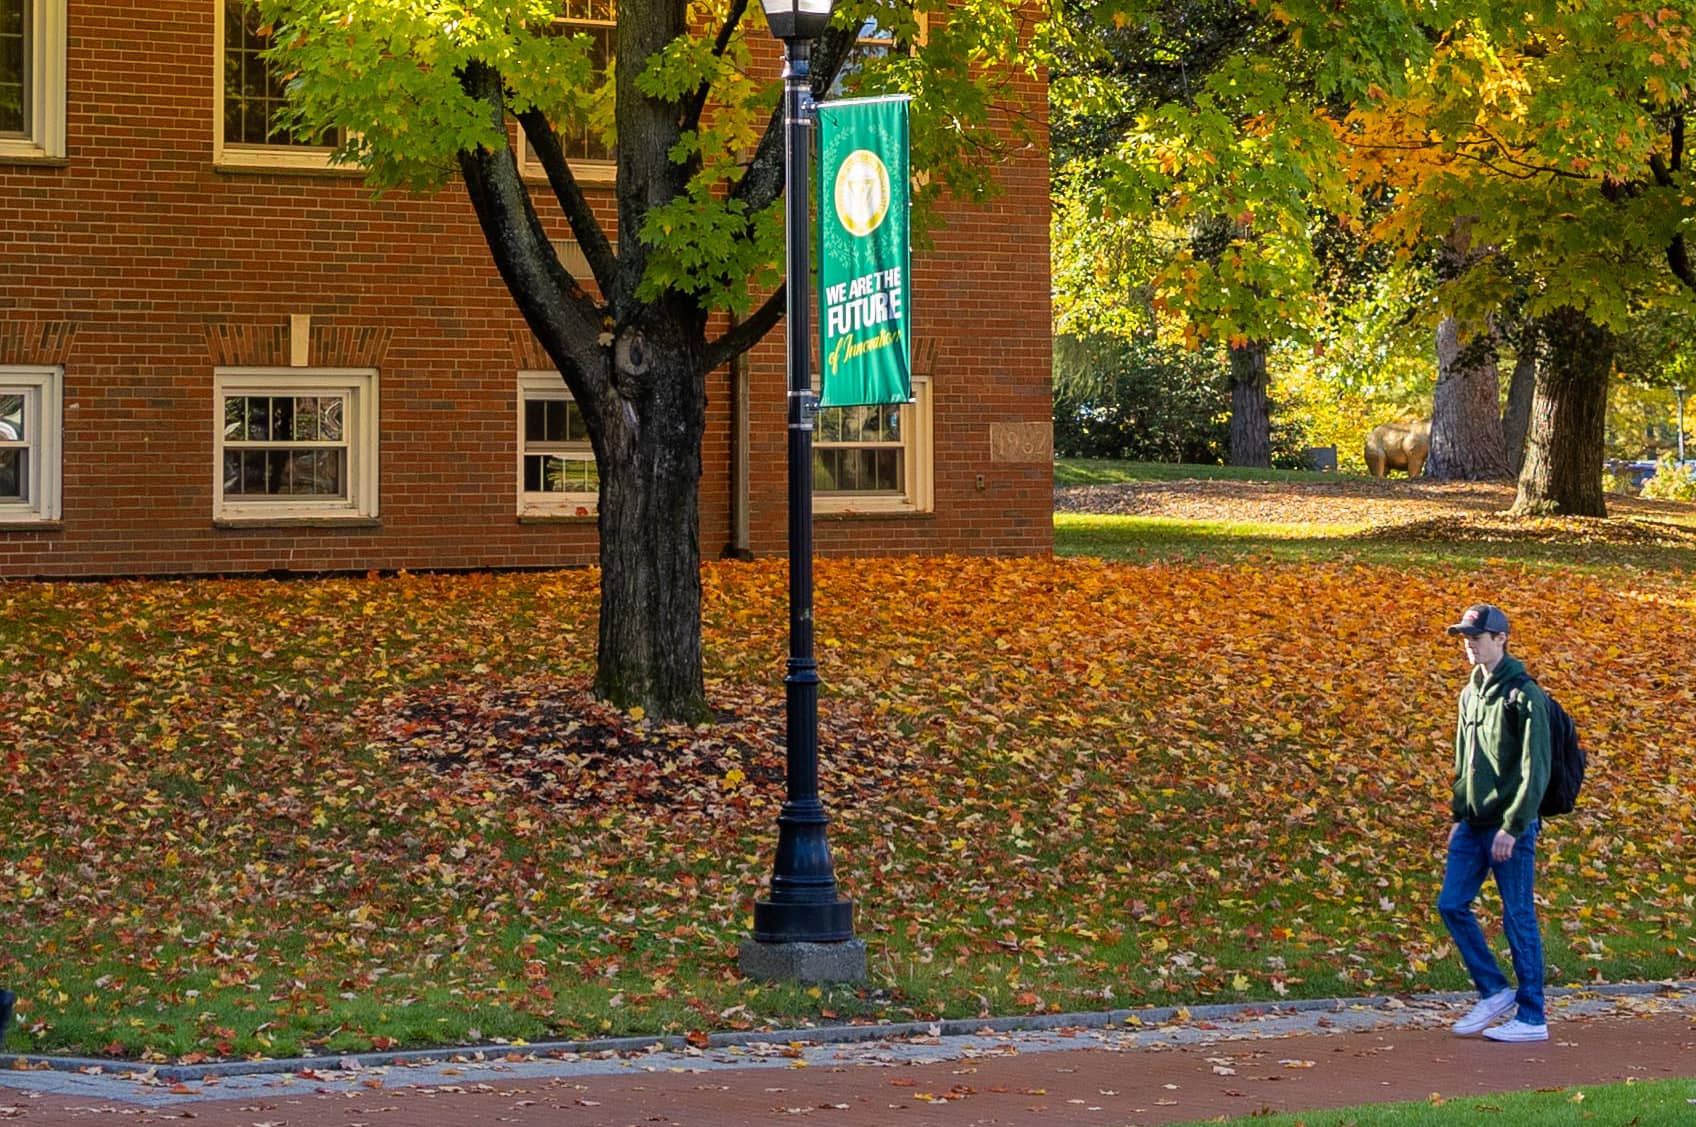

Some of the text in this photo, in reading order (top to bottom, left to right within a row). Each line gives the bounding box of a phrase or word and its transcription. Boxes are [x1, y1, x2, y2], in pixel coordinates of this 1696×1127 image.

[827, 266, 901, 305] WE ARE THE
[828, 289, 901, 337] FUTURE
[829, 338, 843, 375] of
